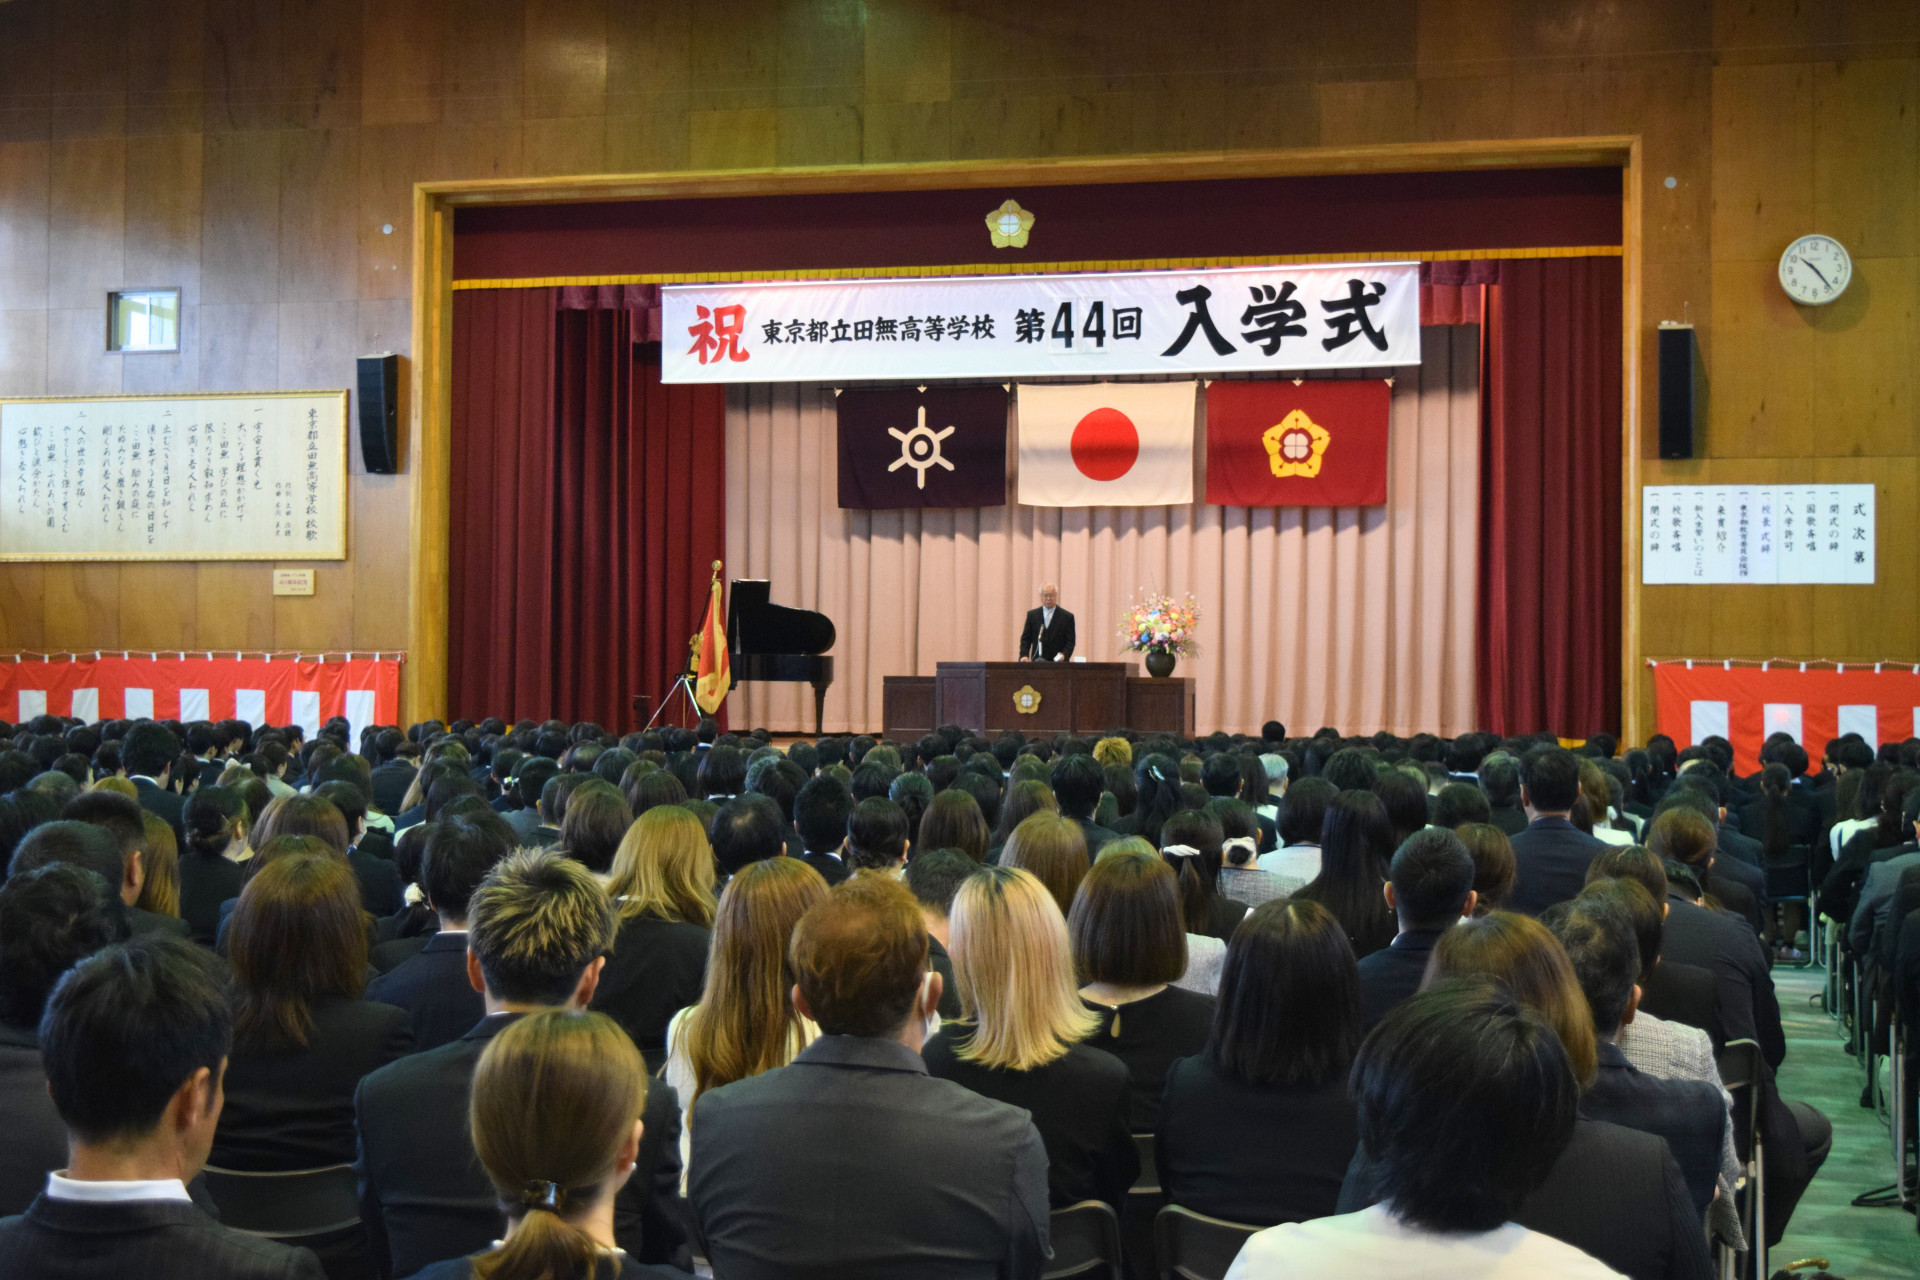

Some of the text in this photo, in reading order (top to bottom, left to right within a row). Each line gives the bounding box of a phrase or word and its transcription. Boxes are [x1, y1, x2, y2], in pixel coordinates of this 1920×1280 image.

[687, 278, 1389, 366] 祝 東京都立田無高等学校 第44回 入学式
[305, 408, 318, 541] 東京都立田無高等学校 校歌
[1852, 502, 1866, 564] 式次第
